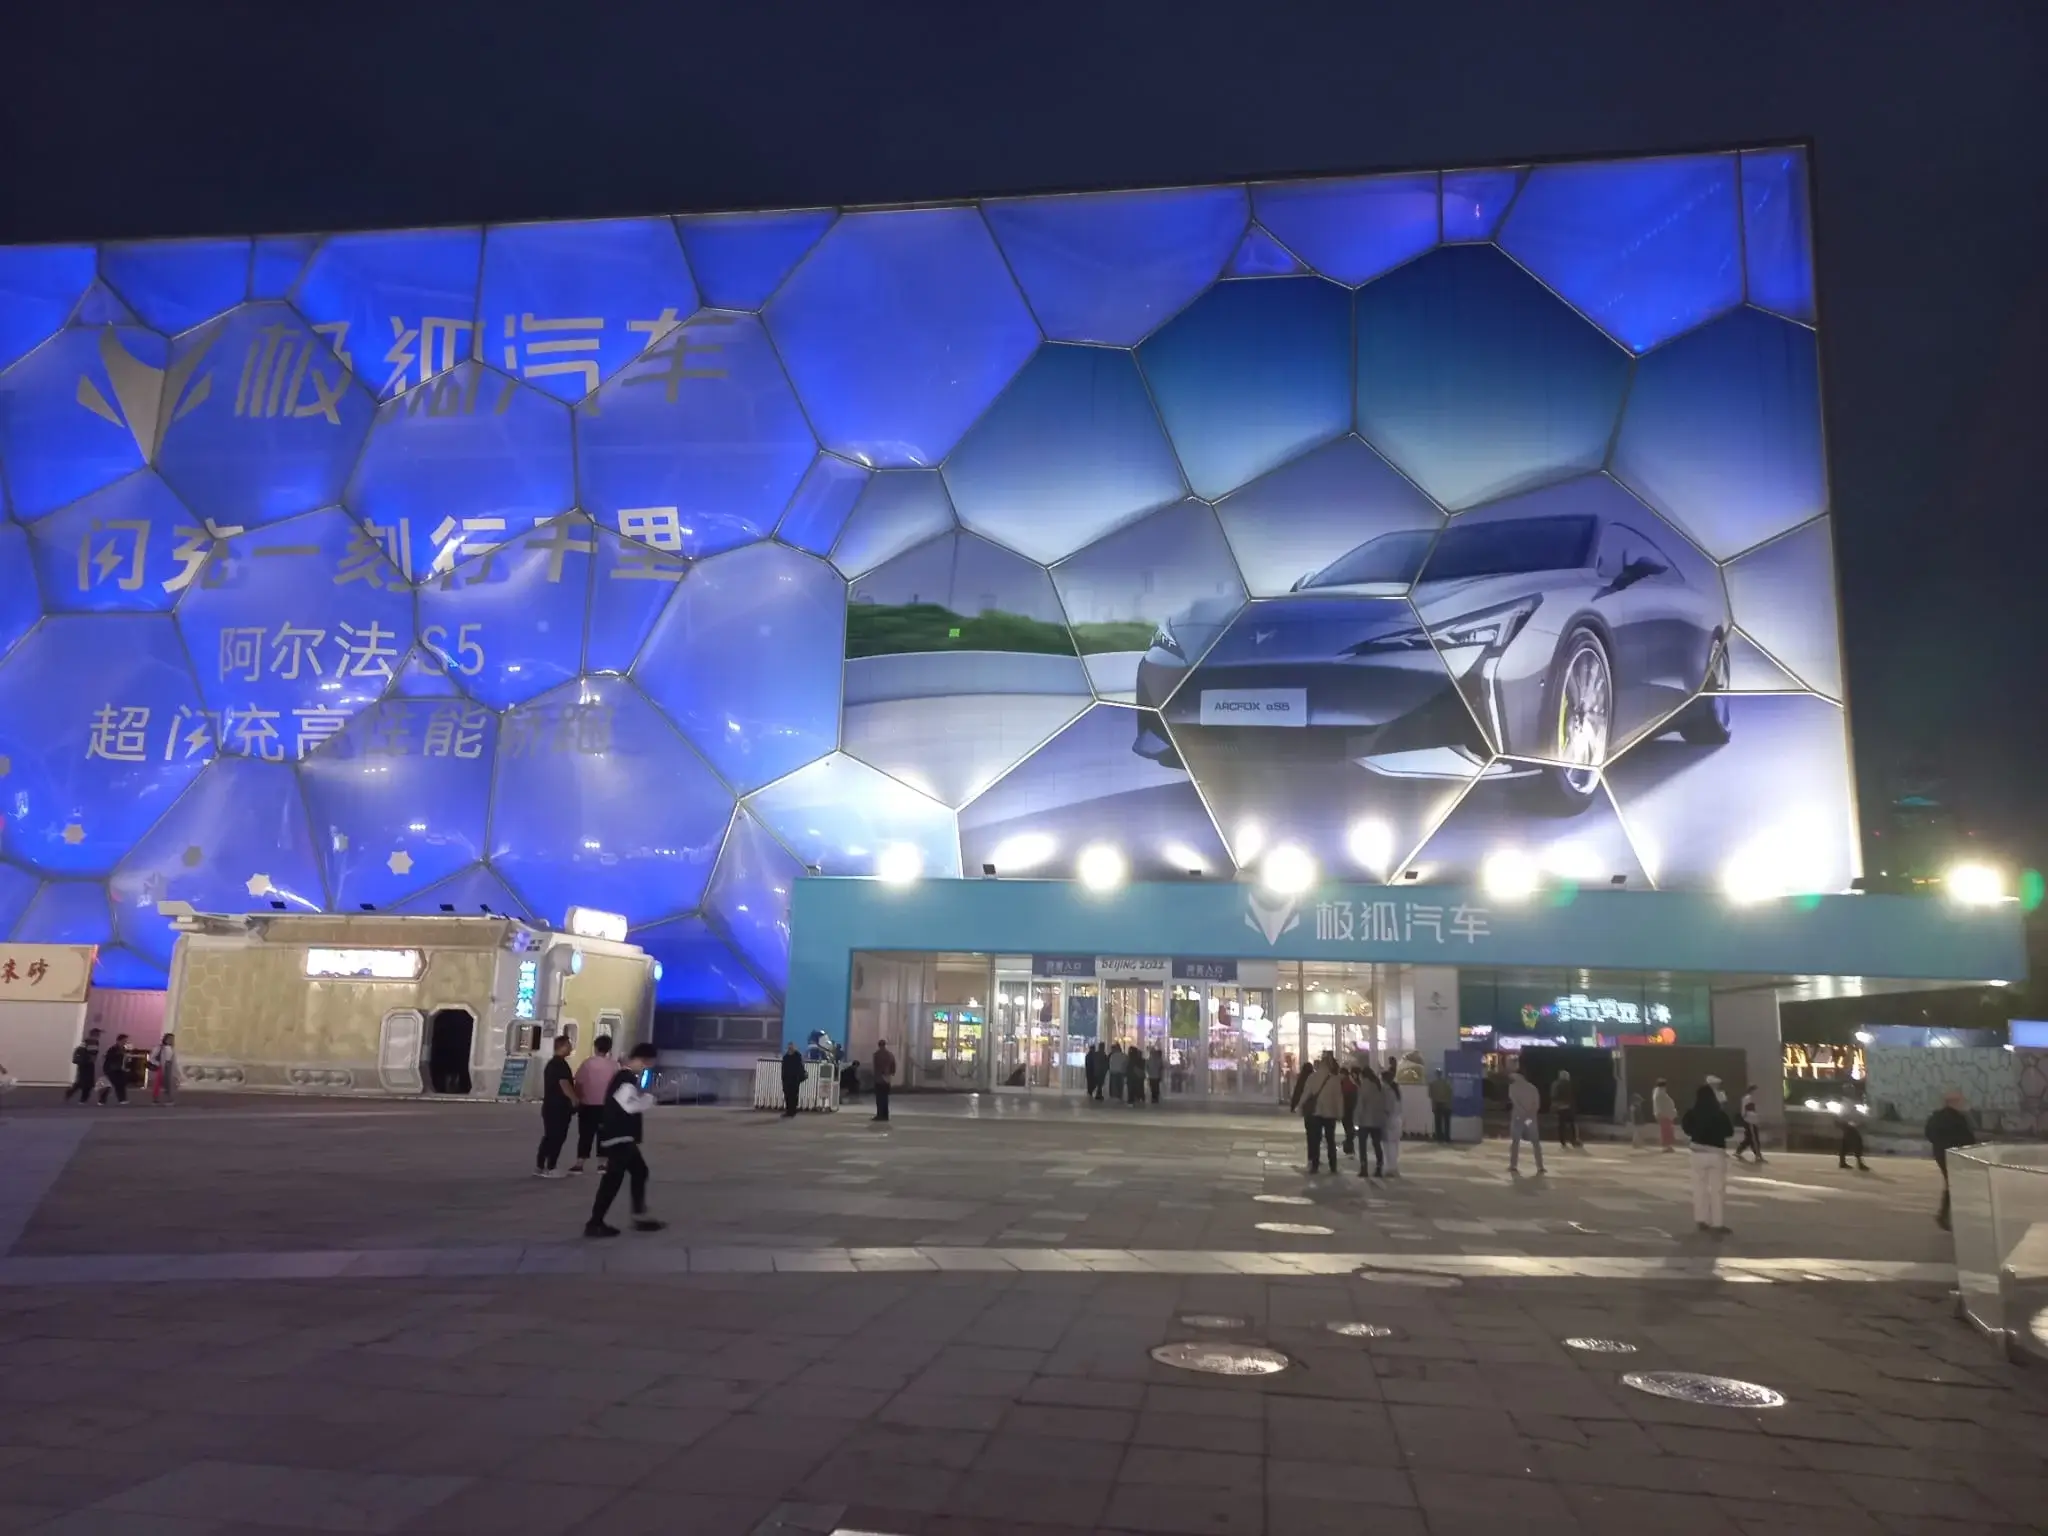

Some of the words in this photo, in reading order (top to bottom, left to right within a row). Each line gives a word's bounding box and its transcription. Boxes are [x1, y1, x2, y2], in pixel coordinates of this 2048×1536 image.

[234, 308, 735, 425] 极狐汽车
[76, 506, 685, 594] 闪充一刻行千里
[218, 619, 398, 683] 阿尔法
[417, 623, 486, 678] S5
[1214, 702, 1261, 712] ARCFOX
[1315, 900, 1491, 944] 极狐汽车
[1101, 959, 1137, 972] BEIJING
[1139, 959, 1167, 970] 2022
